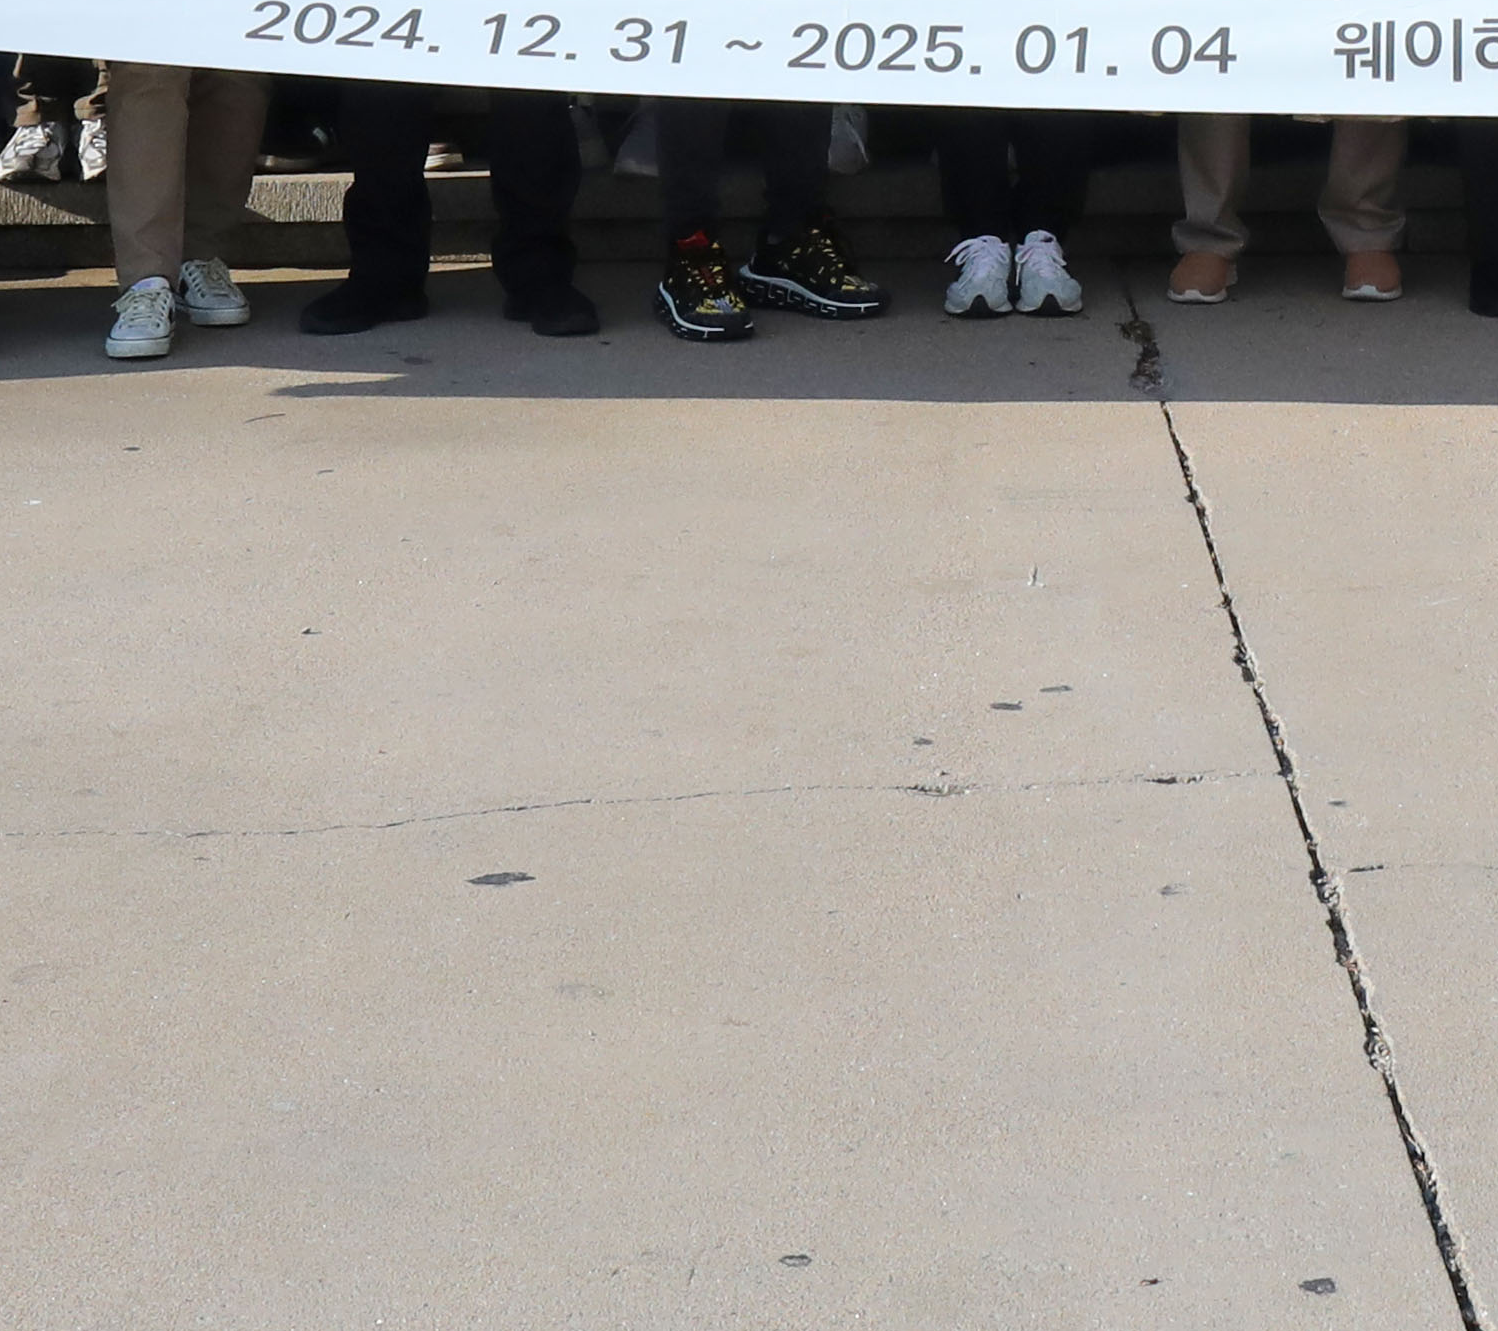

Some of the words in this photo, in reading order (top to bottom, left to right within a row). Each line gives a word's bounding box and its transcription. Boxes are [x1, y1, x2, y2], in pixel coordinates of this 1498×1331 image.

[246, 1, 439, 52] 2024.
[485, 14, 576, 59] 12.
[611, 18, 687, 63] 31
[788, 23, 980, 74] 2025.
[1016, 25, 1117, 75] 01.
[1152, 26, 1236, 74] 04
